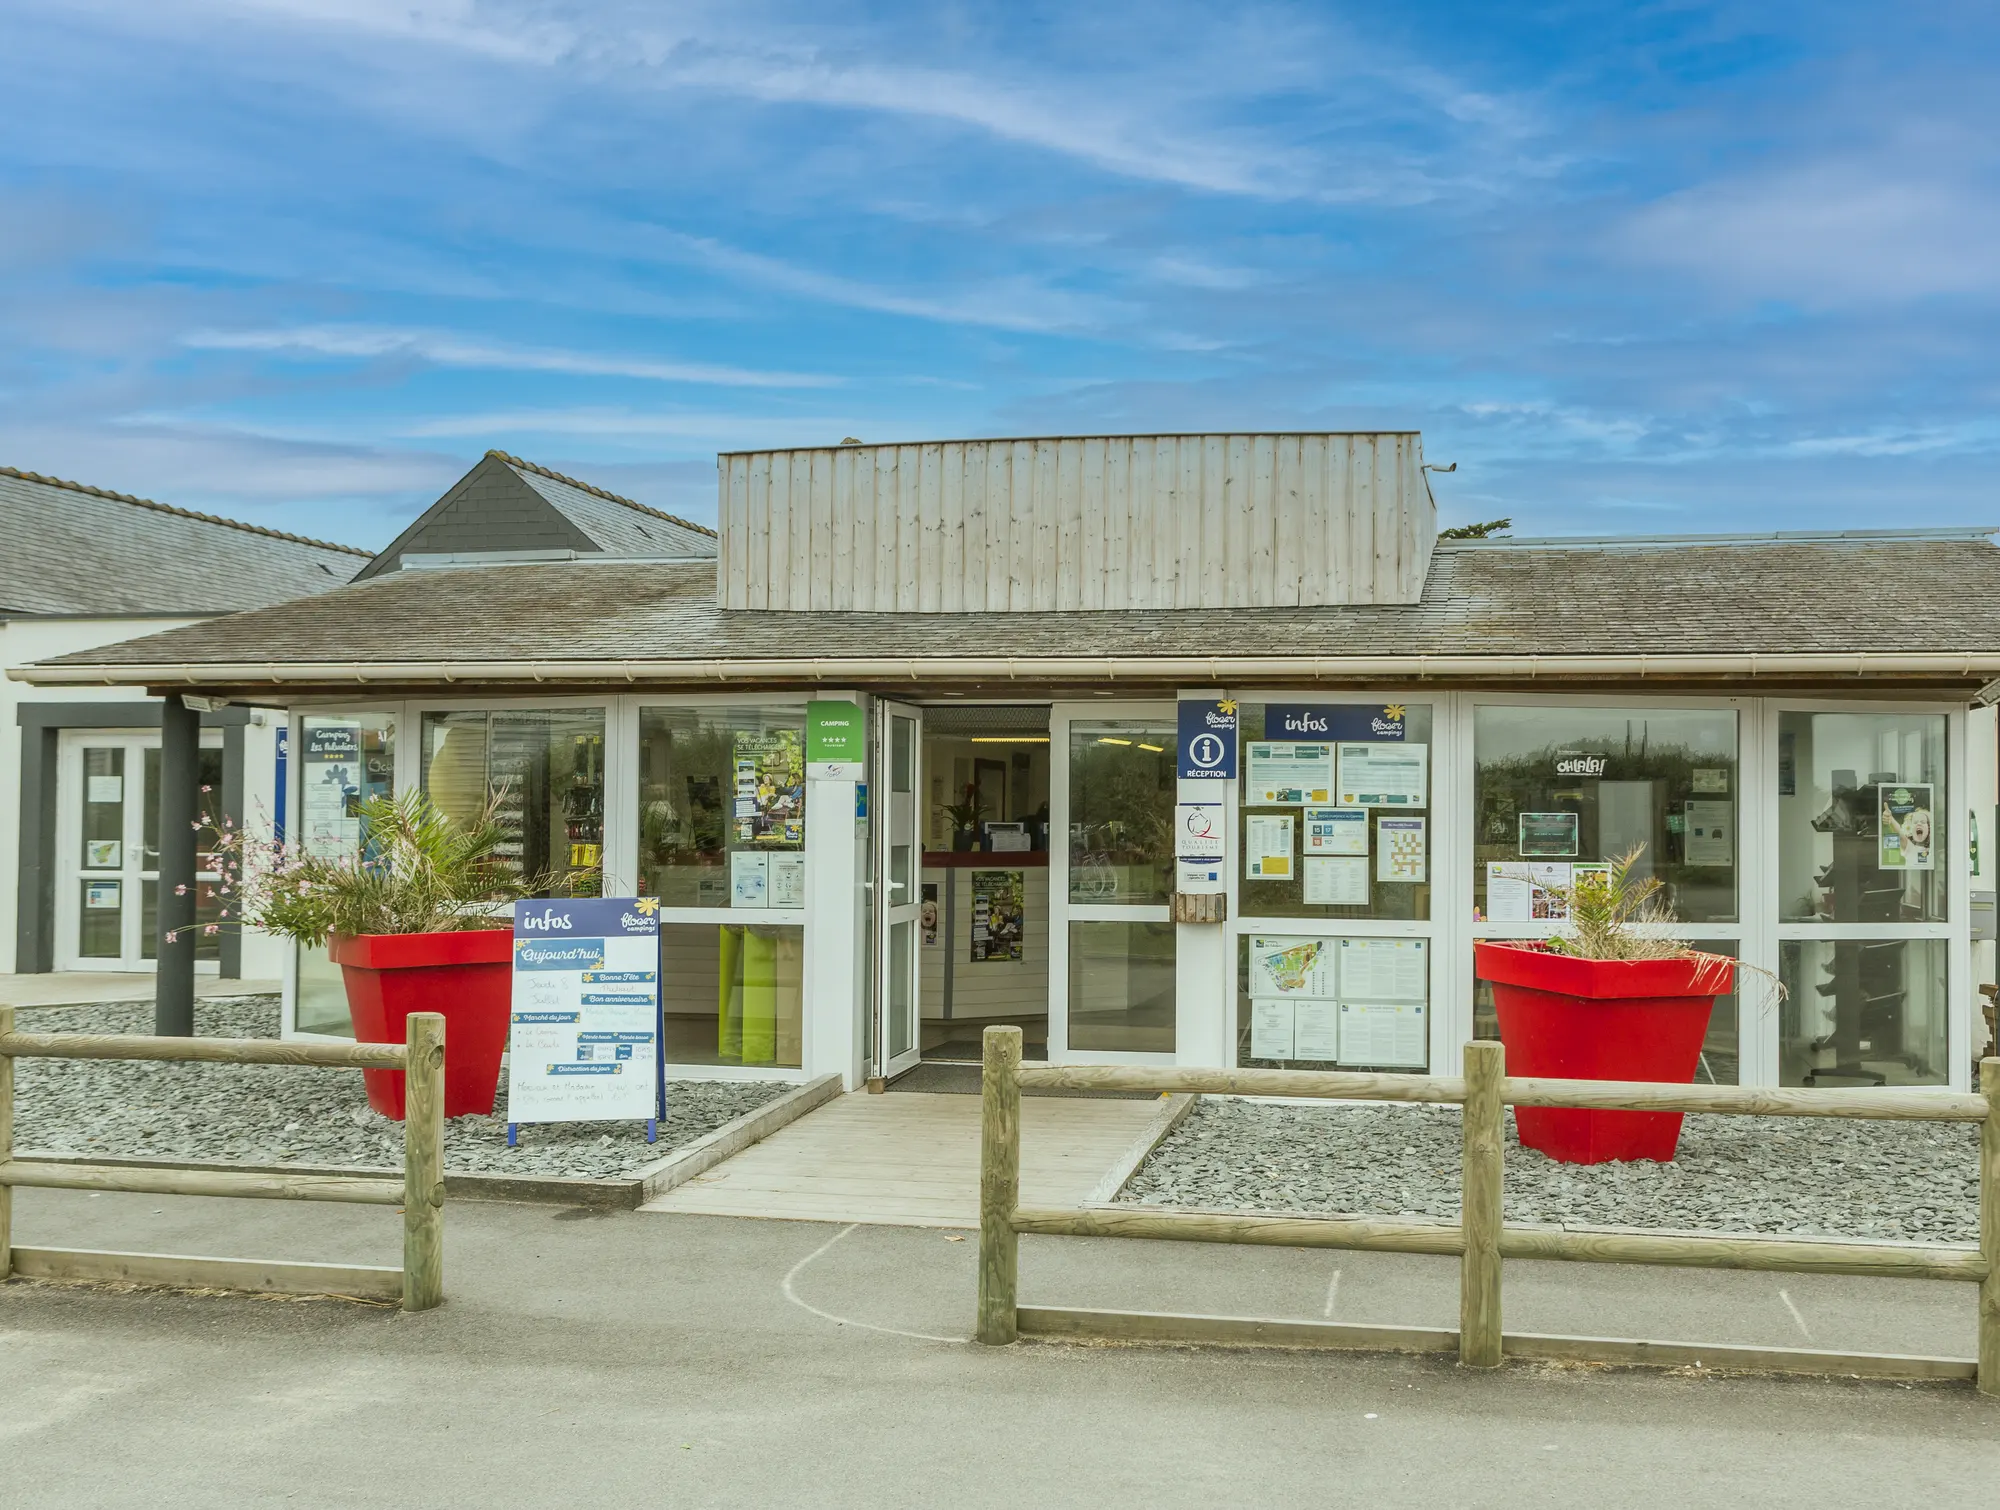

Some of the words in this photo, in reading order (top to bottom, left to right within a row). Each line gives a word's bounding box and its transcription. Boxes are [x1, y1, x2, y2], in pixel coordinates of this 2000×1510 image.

[1206, 711, 1236, 726] flower
[1285, 712, 1329, 732] infos
[1371, 717, 1403, 732] flower
[316, 729, 351, 742] Camping
[1376, 729, 1403, 737] campings
[1186, 768, 1227, 778] RÉCEPTION
[524, 908, 573, 932] infos
[620, 911, 656, 929] flower
[521, 947, 601, 965] Aujourd'hui
[599, 973, 623, 981] Bonne
[623, 973, 640, 981] Fête
[589, 995, 604, 1003] Bon
[605, 995, 649, 1003] anniversaire
[523, 1013, 549, 1021] Marché
[557, 1014, 572, 1022] jour
[598, 1065, 611, 1073] jour
